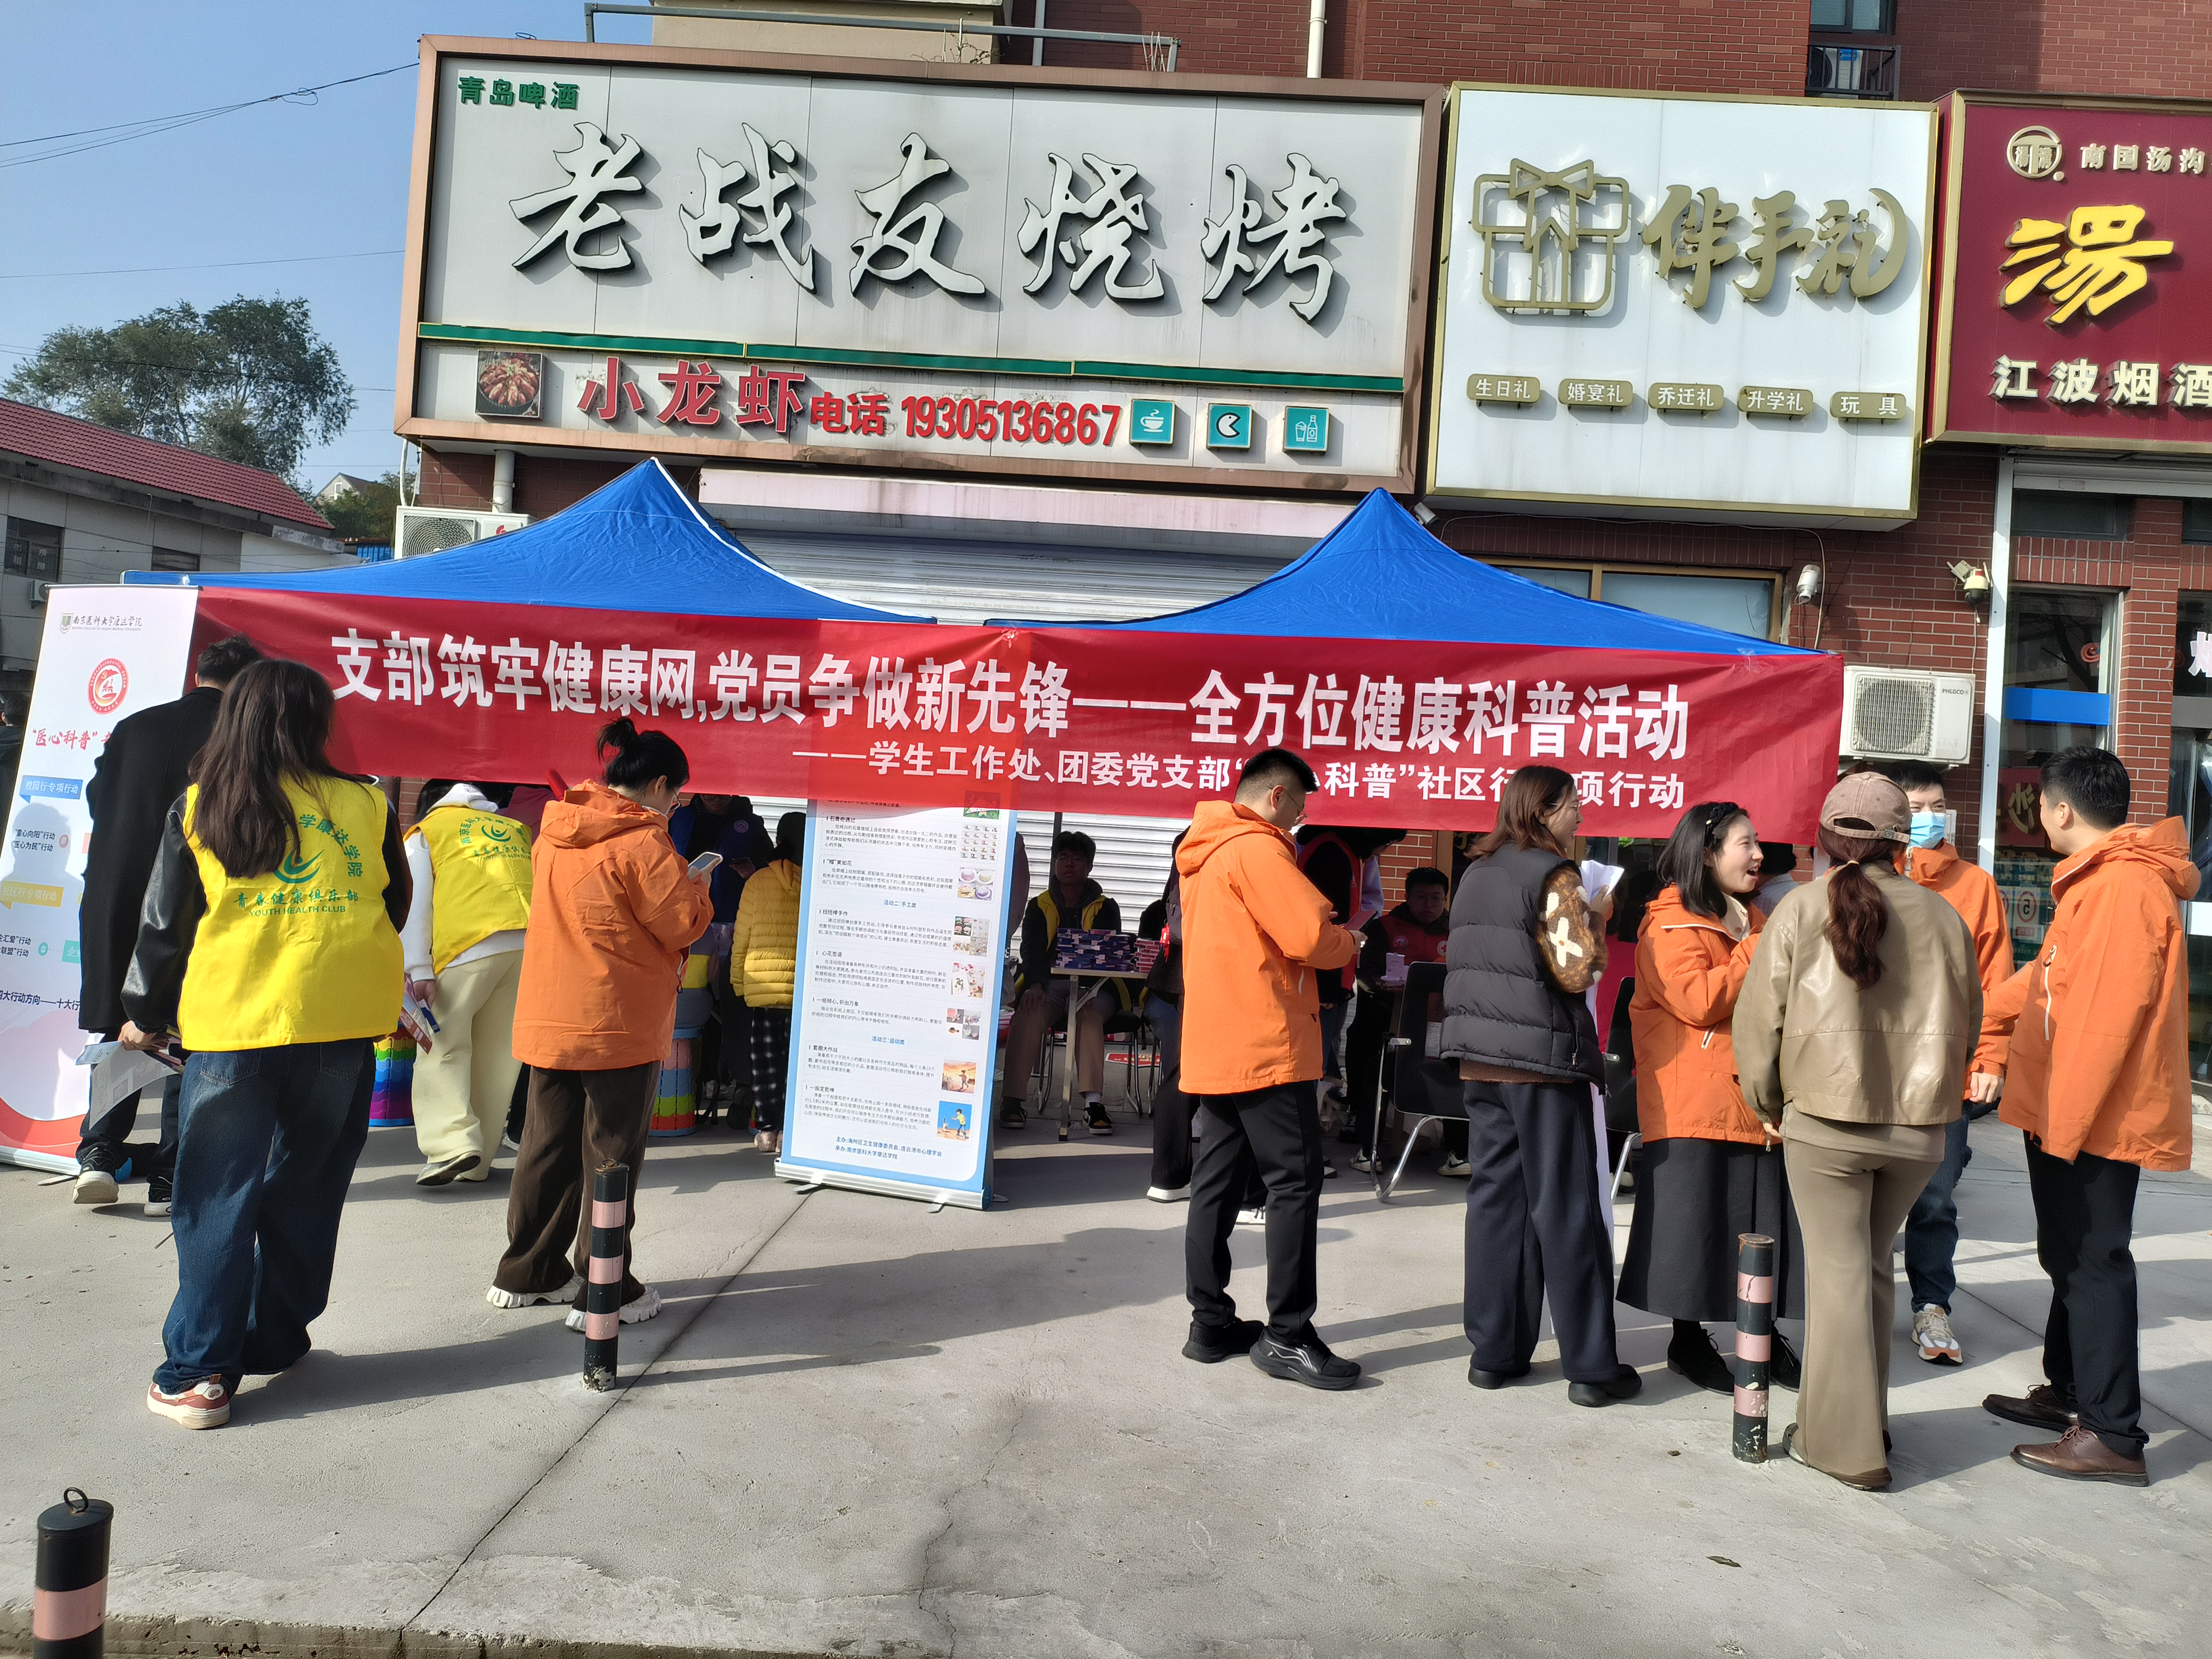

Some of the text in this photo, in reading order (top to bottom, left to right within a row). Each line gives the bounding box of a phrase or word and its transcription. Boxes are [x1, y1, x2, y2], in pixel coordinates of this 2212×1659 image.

[458, 77, 579, 110] 青岛啤酒
[509, 122, 1347, 324] 老战友烧烤
[1642, 185, 1909, 309] 伴手礼
[1475, 378, 1531, 400] 生日礼
[1989, 354, 2212, 408] 江波烟酒
[577, 356, 806, 432] 小龙虾
[1567, 383, 1624, 405] 婚宴礼
[1657, 387, 1715, 408] 乔迁礼
[1747, 391, 1803, 412] 升学礼
[1840, 395, 1899, 416] 玩具
[810, 391, 1124, 446] 电话 19305136867
[793, 740, 1685, 809] ——学生工作处、团委党支部“科普”社区行项行动
[26, 780, 78, 795] 校园行专项行动
[282, 814, 363, 877] 学康达学院
[3, 886, 56, 902] 社区行专项行动
[249, 905, 345, 917] YOUTH HEALTH CLUB
[0, 947, 29, 957] 联盟”行动
